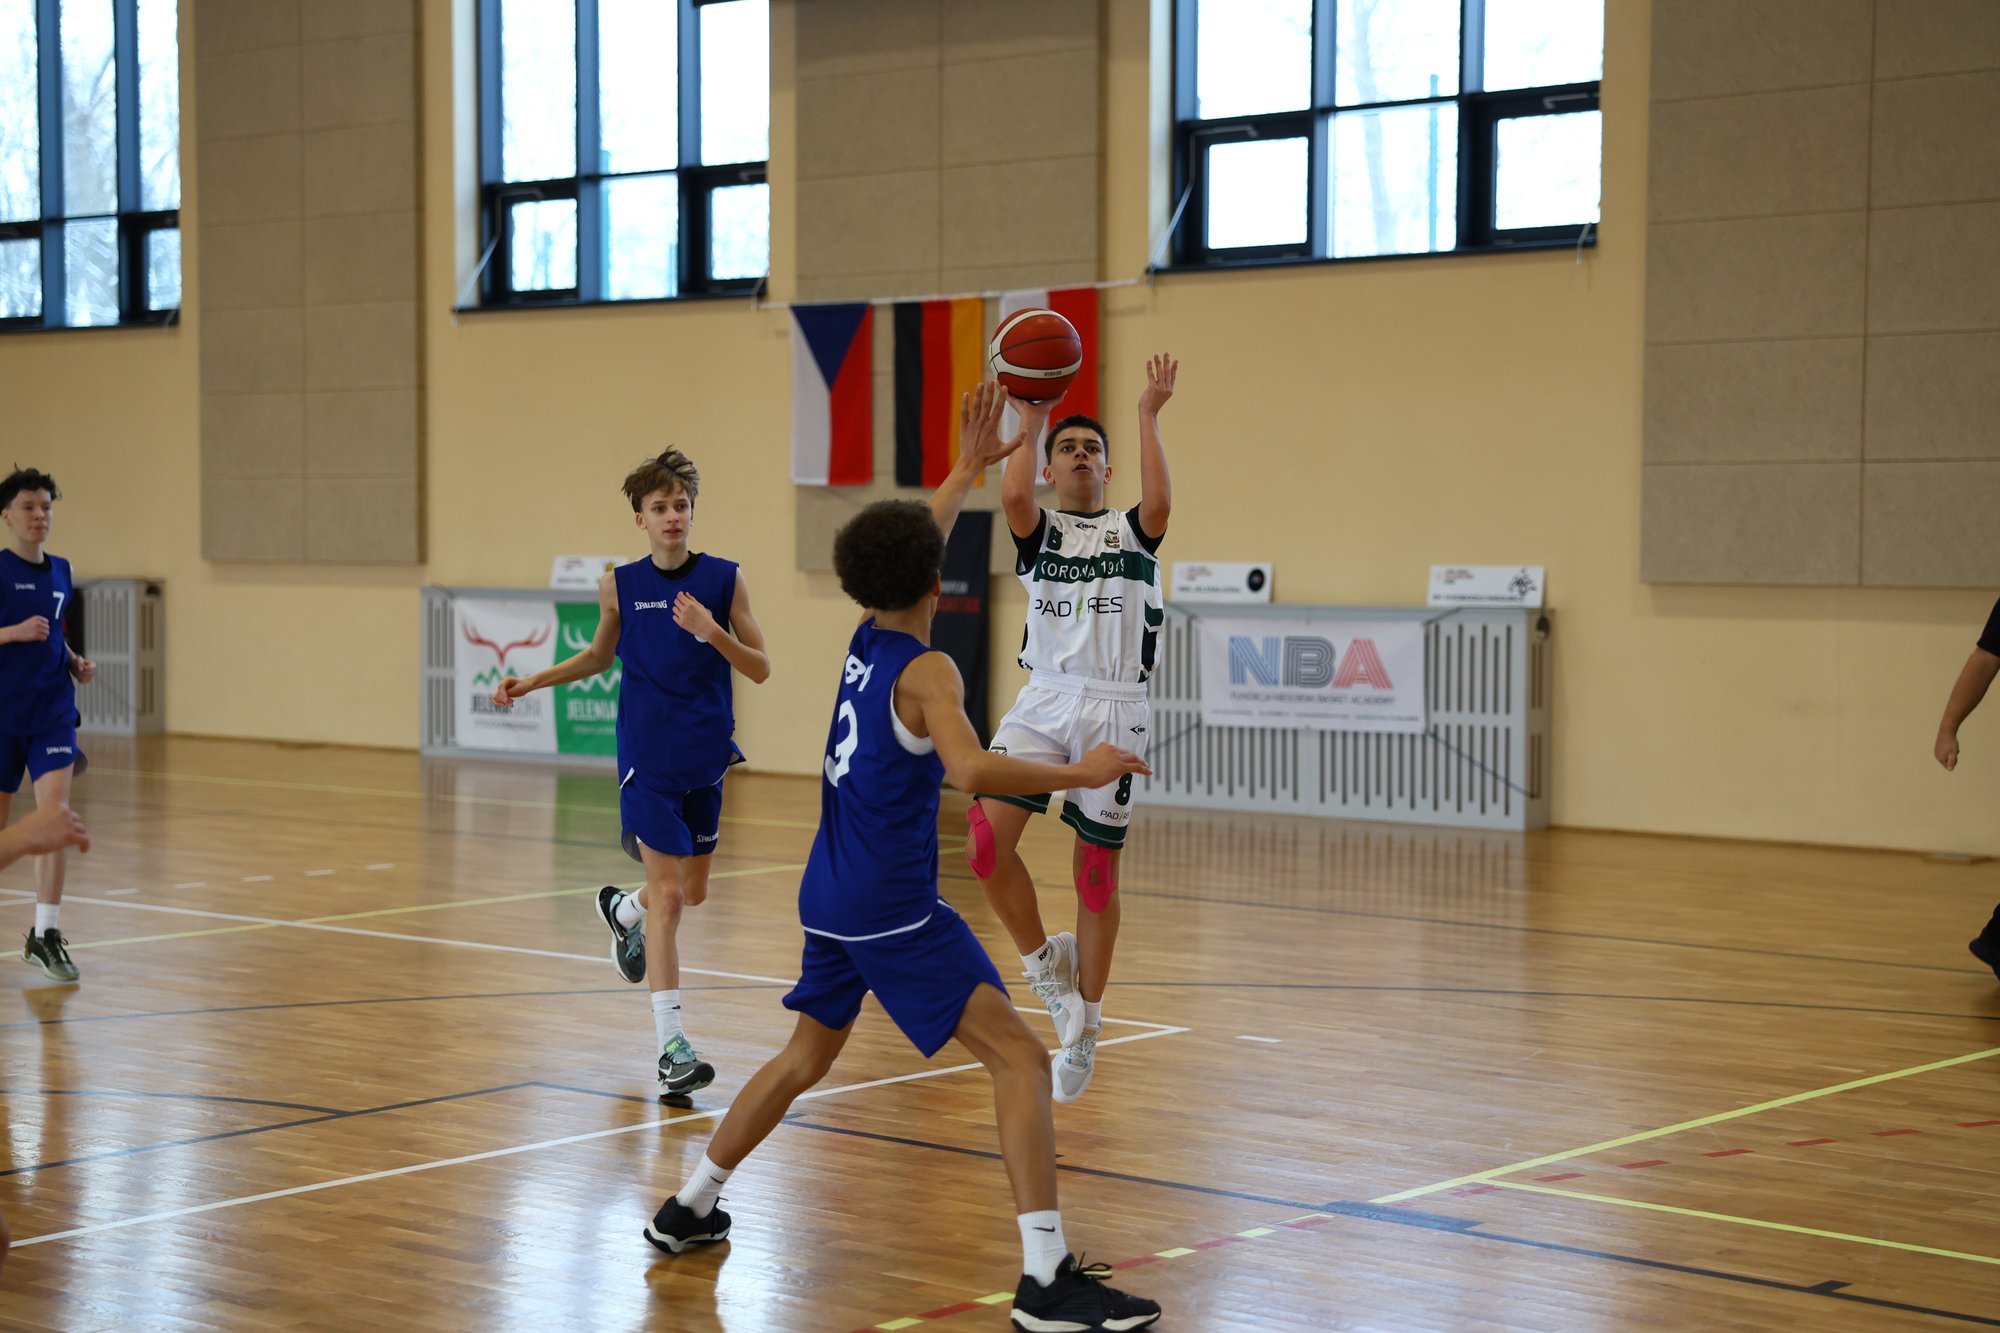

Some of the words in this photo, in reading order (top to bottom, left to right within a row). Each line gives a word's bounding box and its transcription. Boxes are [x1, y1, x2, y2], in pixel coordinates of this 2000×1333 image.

[53, 591, 65, 620] 7
[634, 599, 668, 611] SPALDING
[1035, 599, 1072, 617] PAD
[1087, 596, 1123, 614] RES
[1228, 636, 1394, 689] NBA
[1115, 772, 1133, 806] 8
[1100, 809, 1119, 820] PAD
